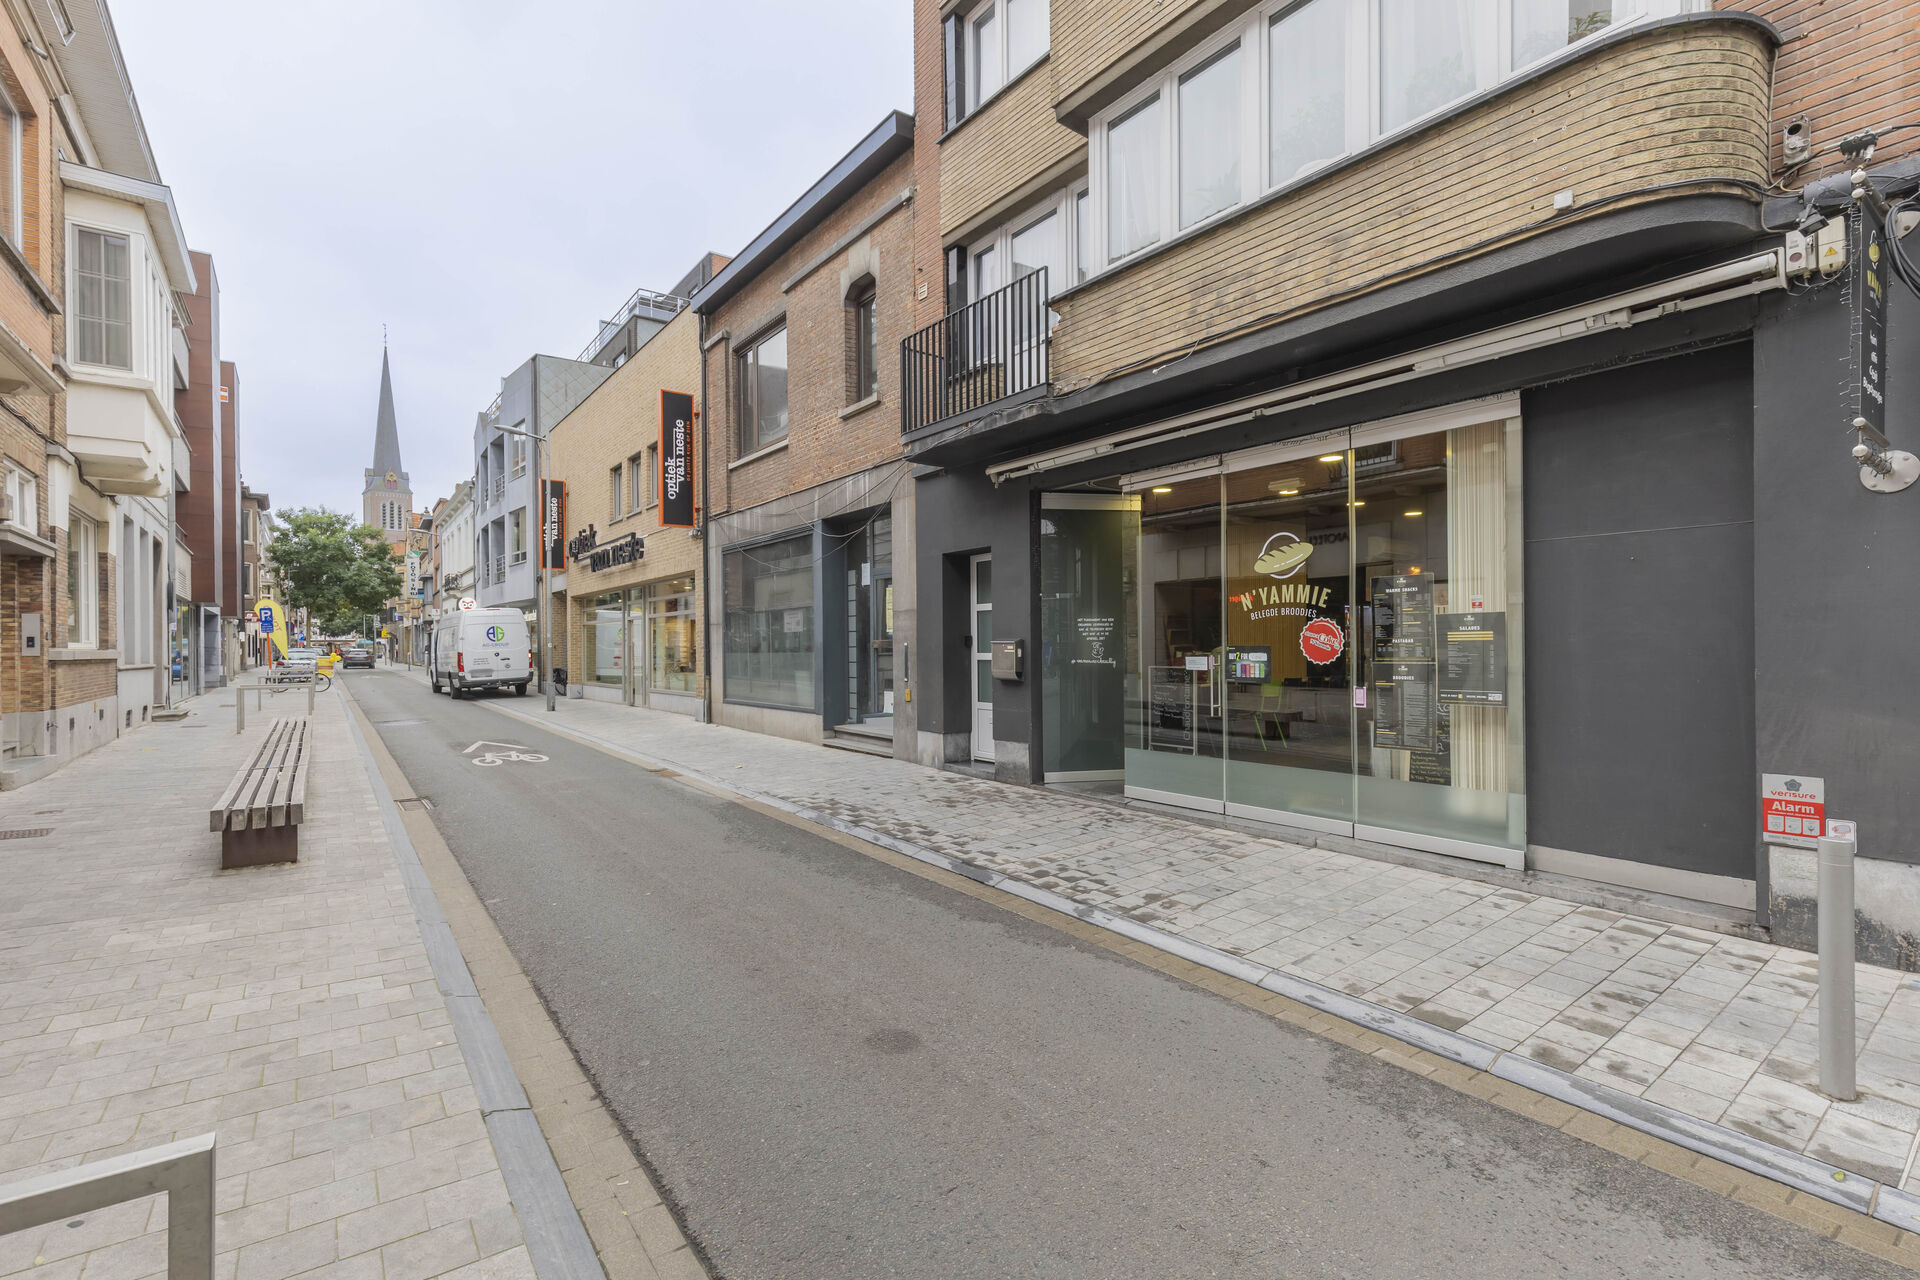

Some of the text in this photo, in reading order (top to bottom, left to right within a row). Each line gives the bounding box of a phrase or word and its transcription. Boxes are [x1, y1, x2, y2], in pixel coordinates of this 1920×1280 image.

[673, 419, 685, 482] van neste
[665, 457, 678, 499] optiek
[550, 497, 558, 522] neste
[1240, 584, 1332, 612] N'YAMMIE
[261, 610, 271, 621] P
[1250, 607, 1317, 620] BELEGDE BROODJES
[1770, 790, 1816, 799] verisure
[1772, 801, 1815, 814] Alarm
